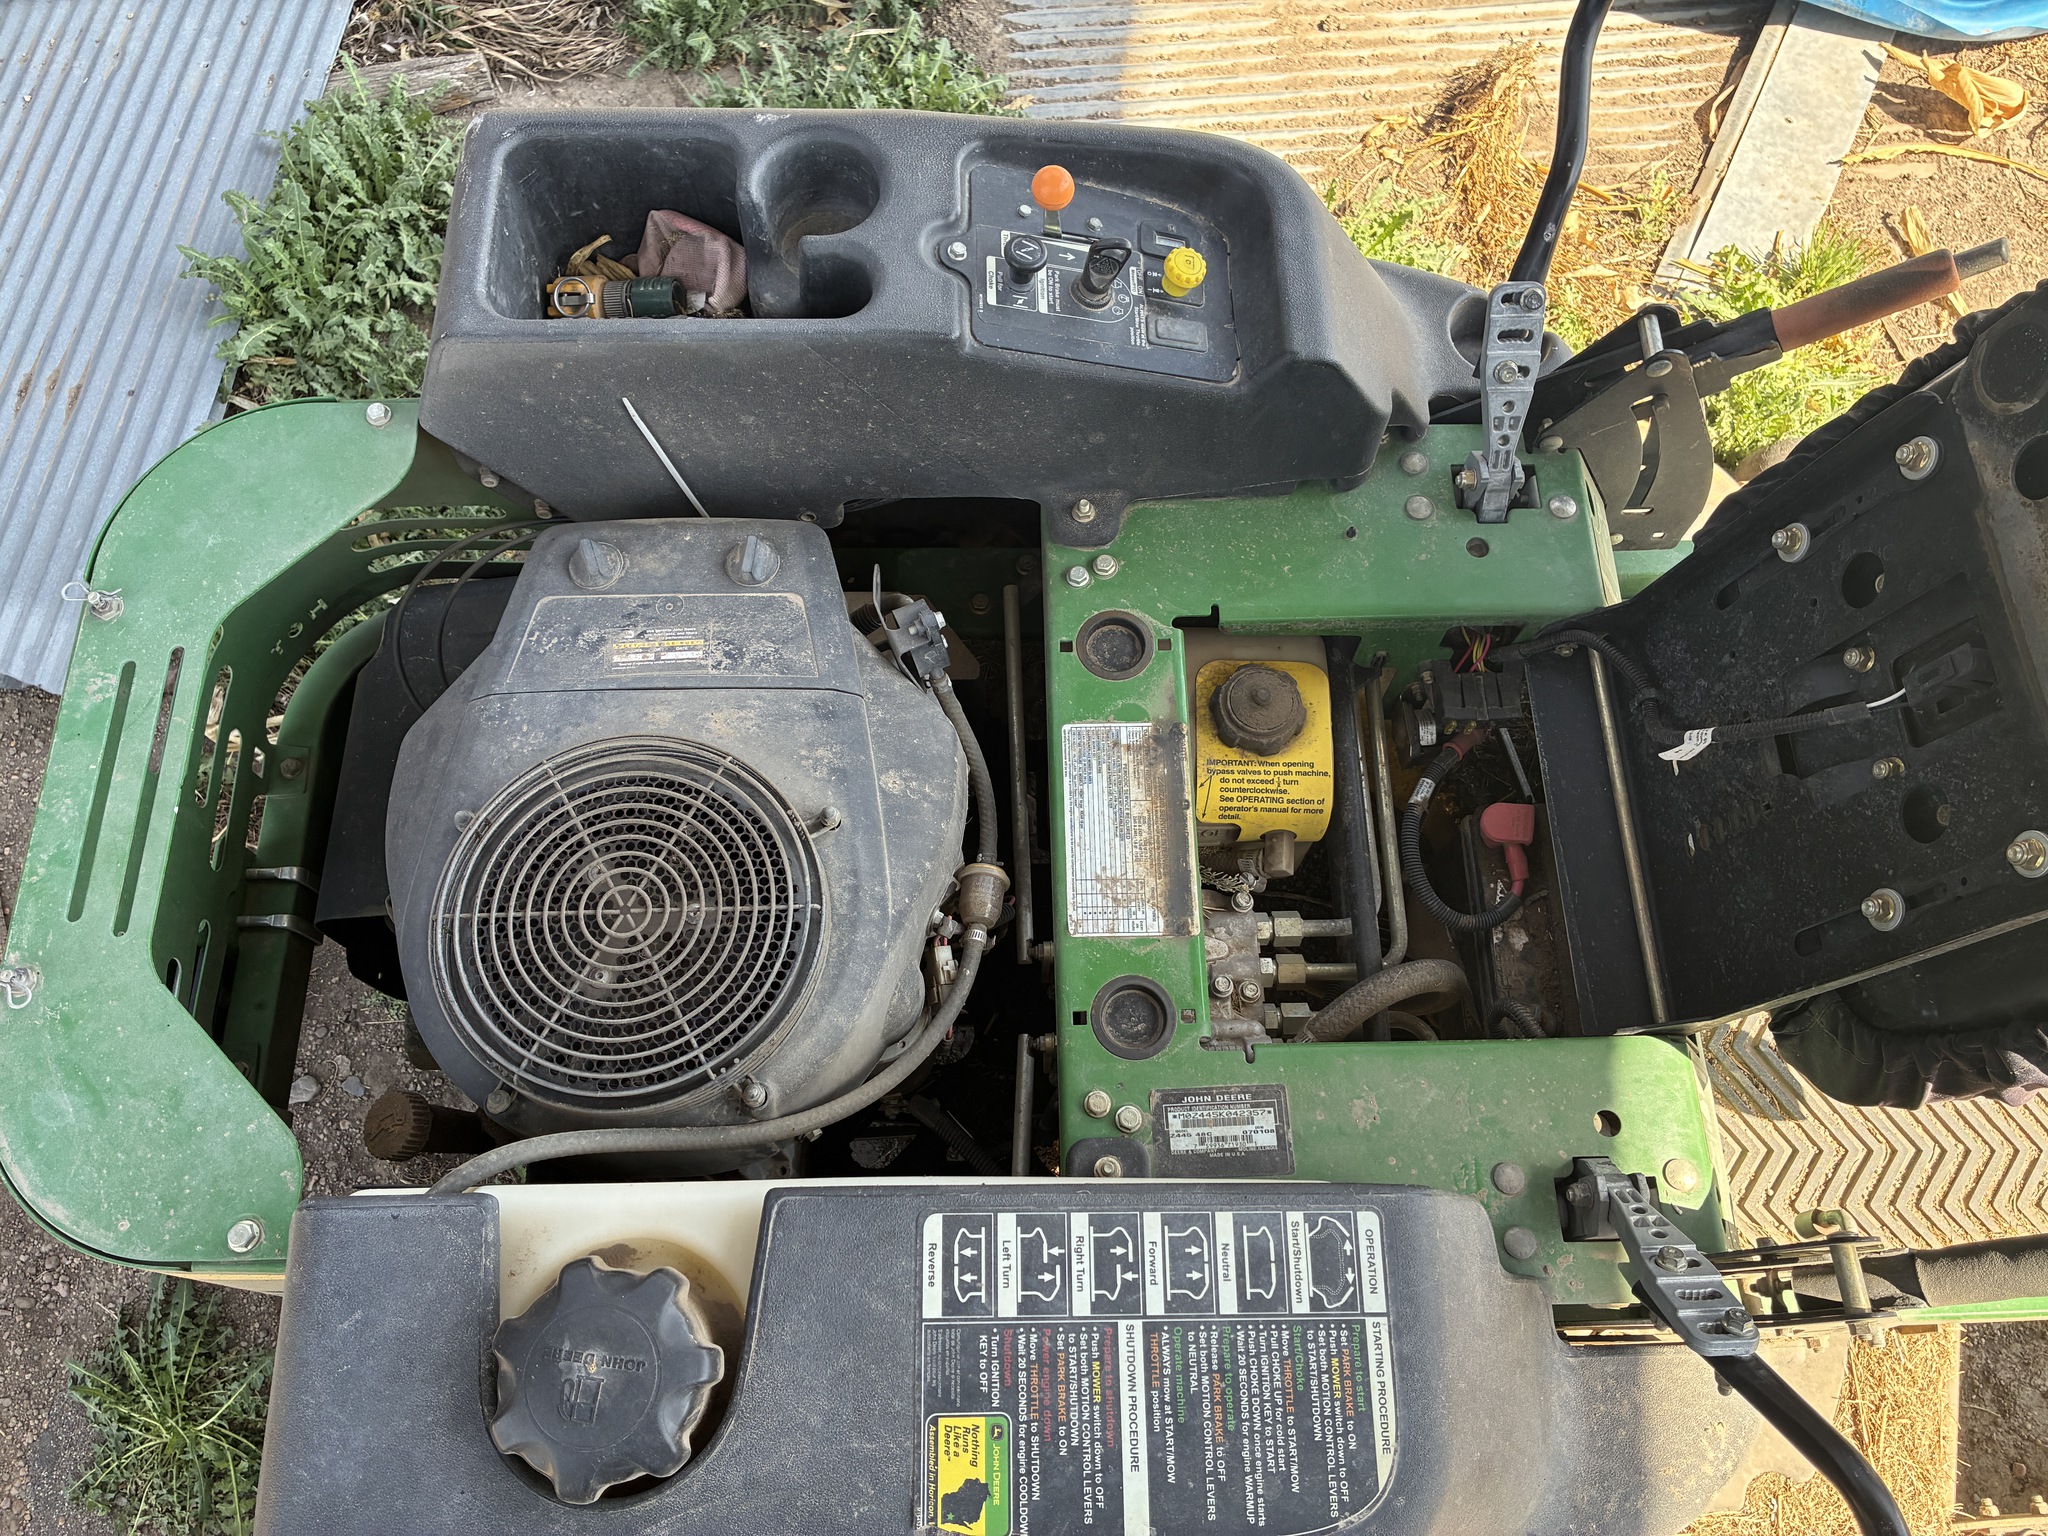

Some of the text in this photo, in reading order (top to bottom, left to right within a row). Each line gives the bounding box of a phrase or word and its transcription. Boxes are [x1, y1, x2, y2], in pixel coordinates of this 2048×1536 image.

[1048, 277, 1053, 285] ON
[1138, 286, 1143, 294] ON
[1207, 759, 1257, 767] IMPORTANT:
[1220, 786, 1290, 794] counterclockwise.
[1236, 796, 1284, 804] OPERATING
[1182, 1095, 1211, 1103] JOHN
[927, 1243, 937, 1287] Reverse
[1002, 1240, 1011, 1288] Left Turn
[1074, 1236, 1085, 1292] Right Turn
[1148, 1241, 1158, 1285] Forward
[1221, 1243, 1231, 1281] Neutral
[1291, 1221, 1303, 1304] Start/Shutdown
[1365, 1229, 1377, 1294] OPERATION
[543, 1346, 648, 1372] JOHN DEERE
[980, 1359, 987, 1369] to
[991, 1335, 999, 1357] Turn
[1018, 1334, 1026, 1355] Wait
[1018, 1358, 1027, 1368] 20
[1293, 1326, 1304, 1391] Start/Choke
[1319, 1349, 1328, 1371] both
[1173, 1327, 1186, 1423] Operate machine
[1221, 1326, 1235, 1431] Prepare to operate
[1307, 1330, 1322, 1441] to START/SHUTDOWN
[1340, 1330, 1356, 1449] Set PARK BRAKE to ON
[1351, 1324, 1366, 1412] Prepare to start
[1372, 1321, 1391, 1455] STARTING PROCEDURE
[1018, 1371, 1028, 1421] SECONDS
[1126, 1324, 1139, 1472] SHUTDOWN PROCEDURE
[1161, 1332, 1176, 1484] ALWAYS mow at START/MOW
[1210, 1332, 1225, 1481] Release PARK BRAKE to OFF
[1259, 1331, 1275, 1473] Turn IGNITION KEY to START
[1270, 1331, 1286, 1471] Pull CHOKE UP for cold start
[1281, 1331, 1299, 1492] Move THROTTLE to START/MOW
[1321, 1374, 1332, 1415] MOTION
[1329, 1330, 1349, 1502] Push MOWER switch down to OFF
[953, 1426, 961, 1448] Like
[970, 1424, 979, 1467] Nothing
[1019, 1424, 1028, 1437] for
[1236, 1331, 1255, 1524] Wait 20 SECONDS for engine WARMUP
[1248, 1331, 1266, 1526] Push CHOKE DOWN once engine starts
[1324, 1418, 1335, 1471] CONTROL
[1017, 1440, 1027, 1474] engine
[928, 1484, 936, 1518] Horicon,
[1328, 1475, 1338, 1517] LEVERS
